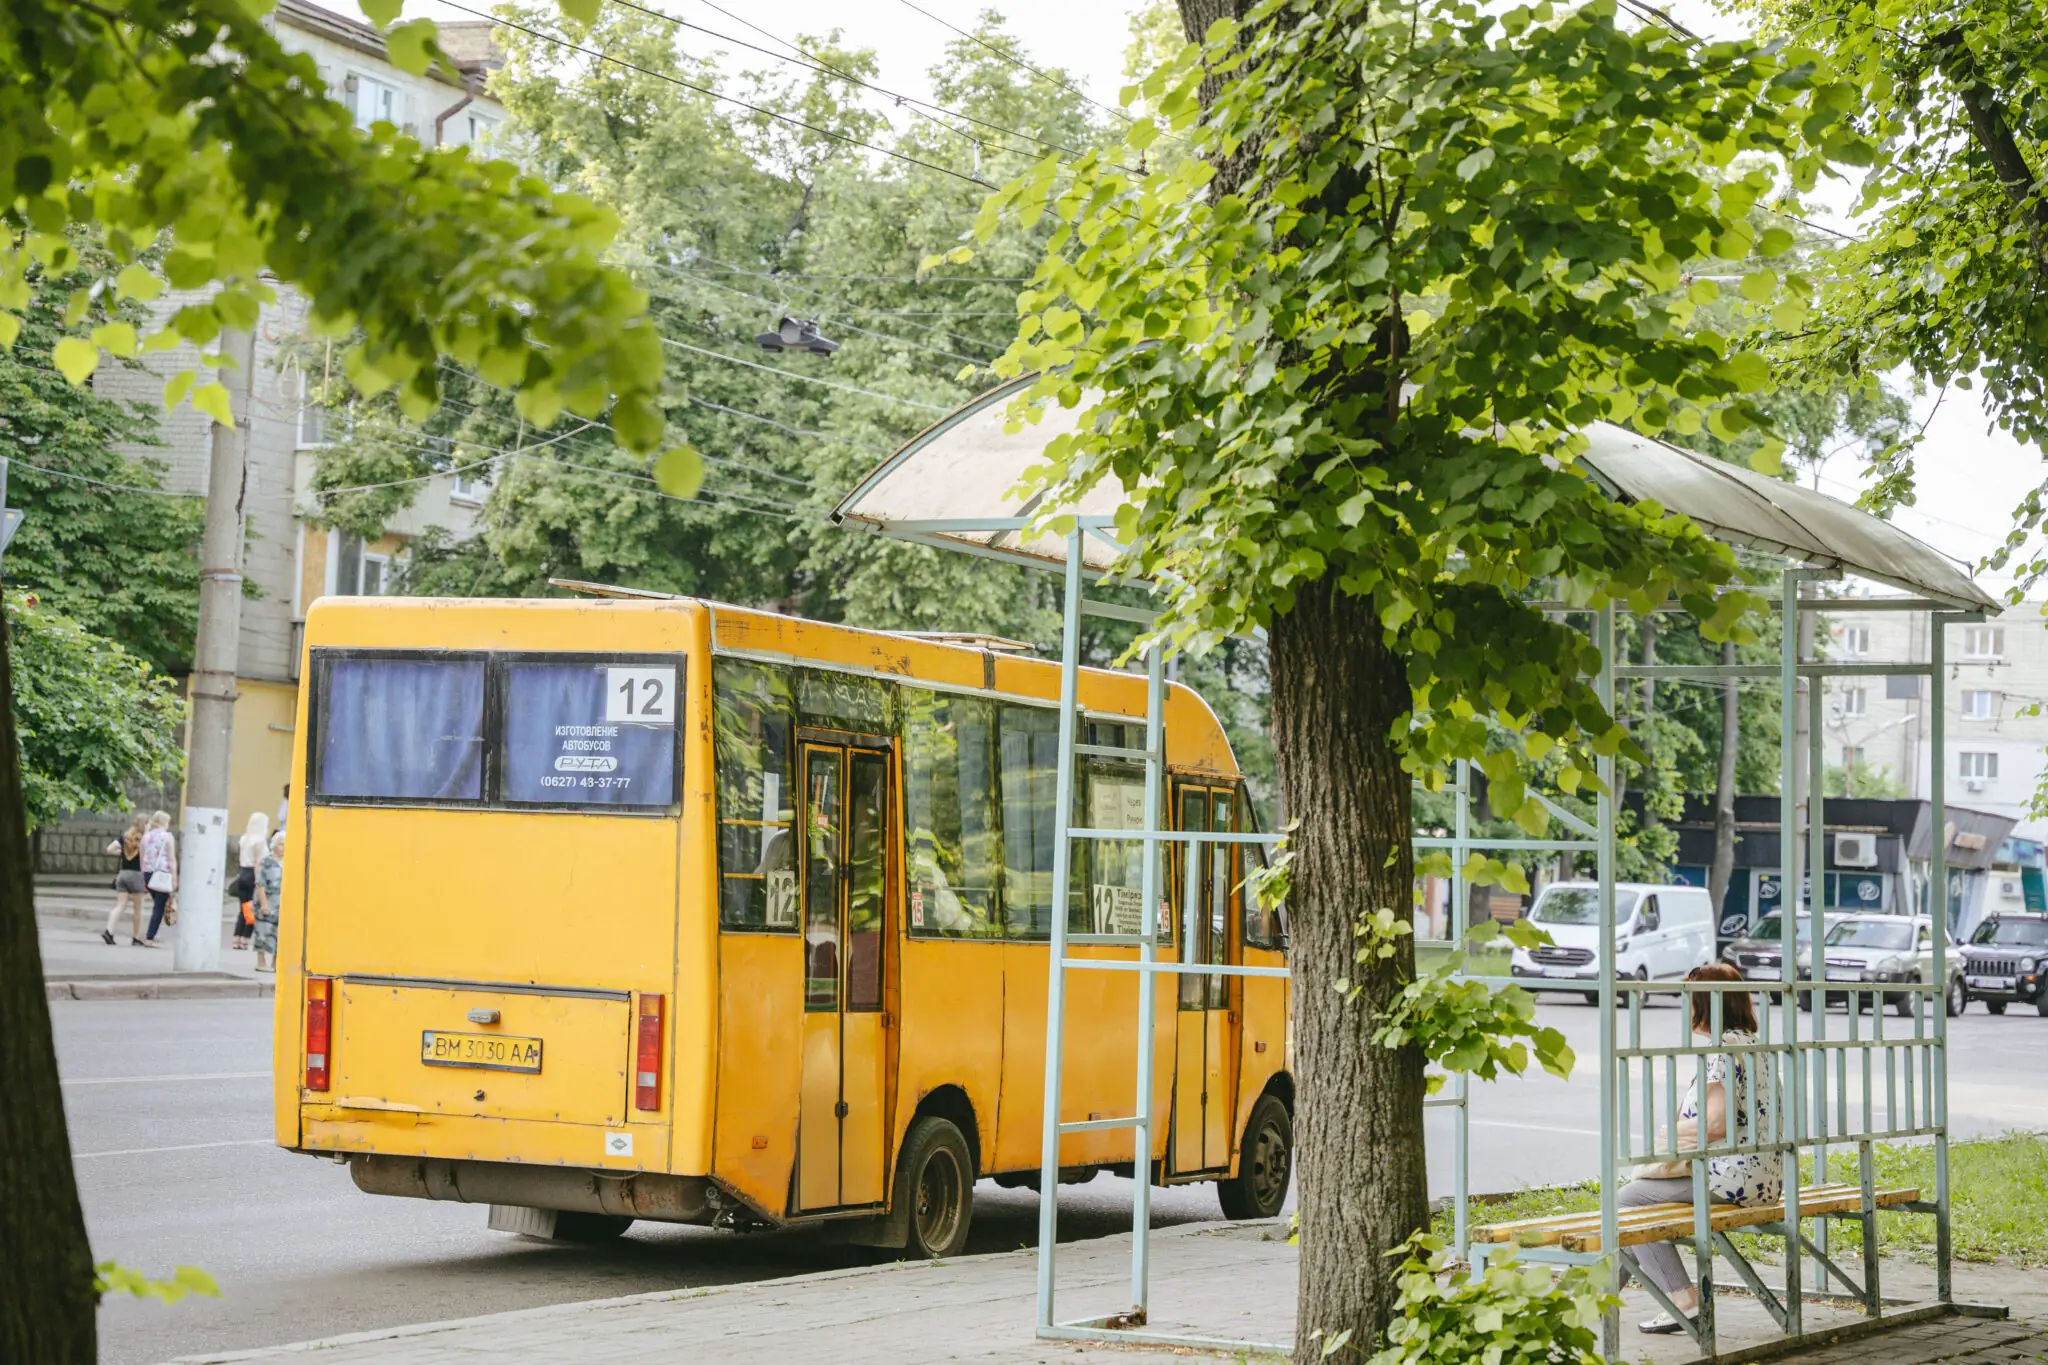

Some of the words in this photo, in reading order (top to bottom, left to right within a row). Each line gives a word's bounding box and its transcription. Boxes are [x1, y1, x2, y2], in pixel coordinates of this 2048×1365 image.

[619, 678, 664, 715] 12
[555, 725, 619, 737] ИЗГОТОВЛЕНИЕ
[562, 740, 611, 751] АВТОБУСОВ
[559, 757, 612, 770] РУТА
[540, 776, 577, 788] (0627)
[770, 877, 794, 922] 12
[1096, 886, 1114, 934] 12
[912, 901, 923, 923] 15
[435, 1037, 461, 1057] BM
[466, 1040, 505, 1060] 3030
[511, 1043, 536, 1063] AA
